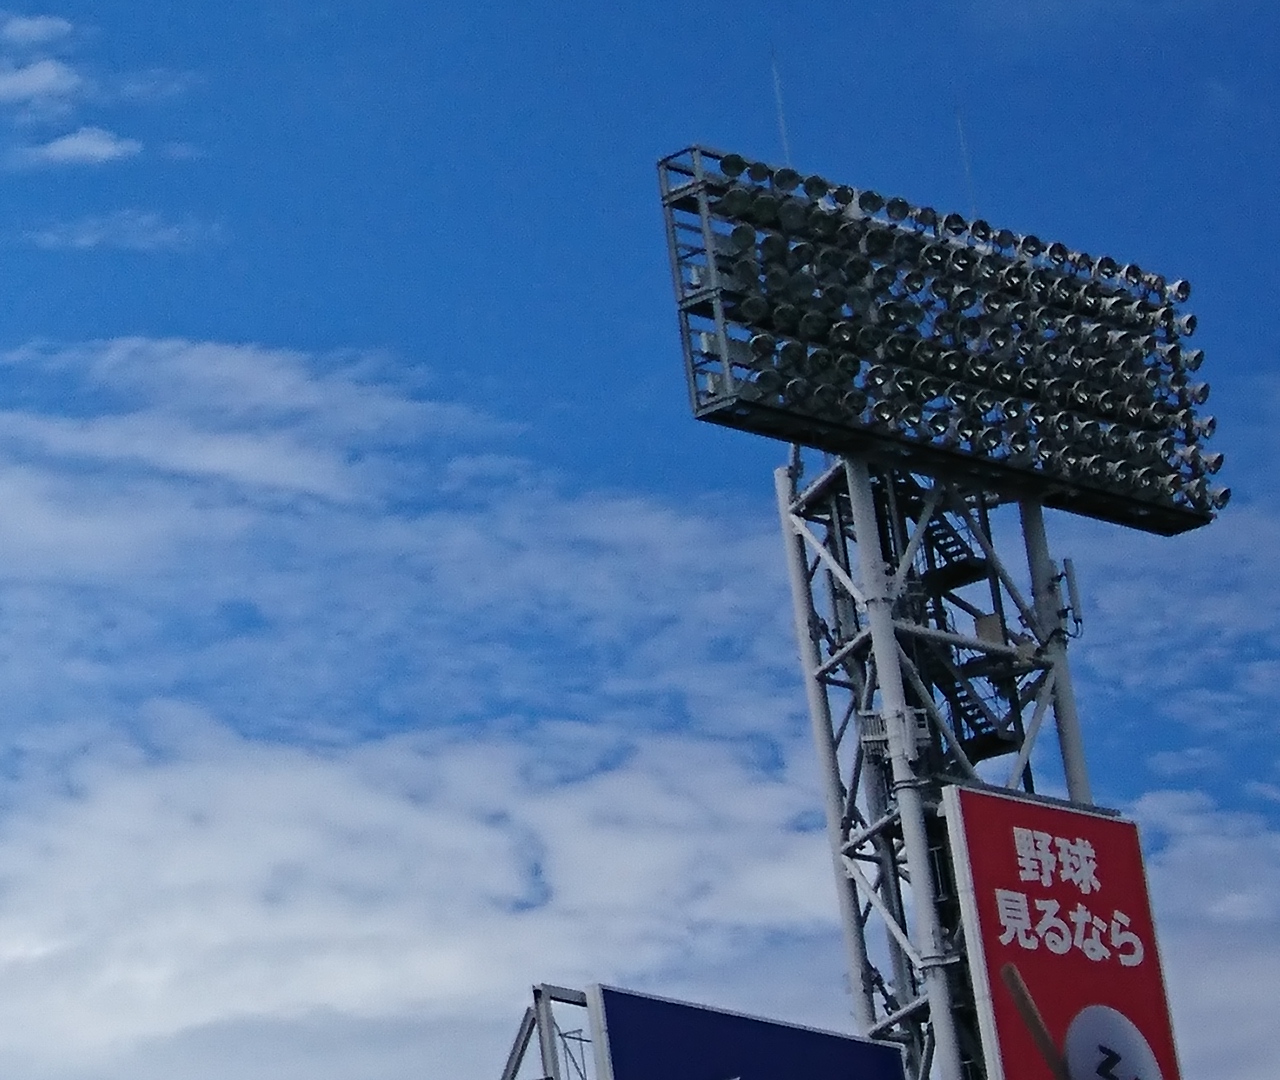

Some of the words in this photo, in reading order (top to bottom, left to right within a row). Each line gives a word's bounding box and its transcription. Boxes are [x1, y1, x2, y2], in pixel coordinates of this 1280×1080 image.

[1012, 825, 1102, 894] 野球
[994, 887, 1145, 967] 見るなら
